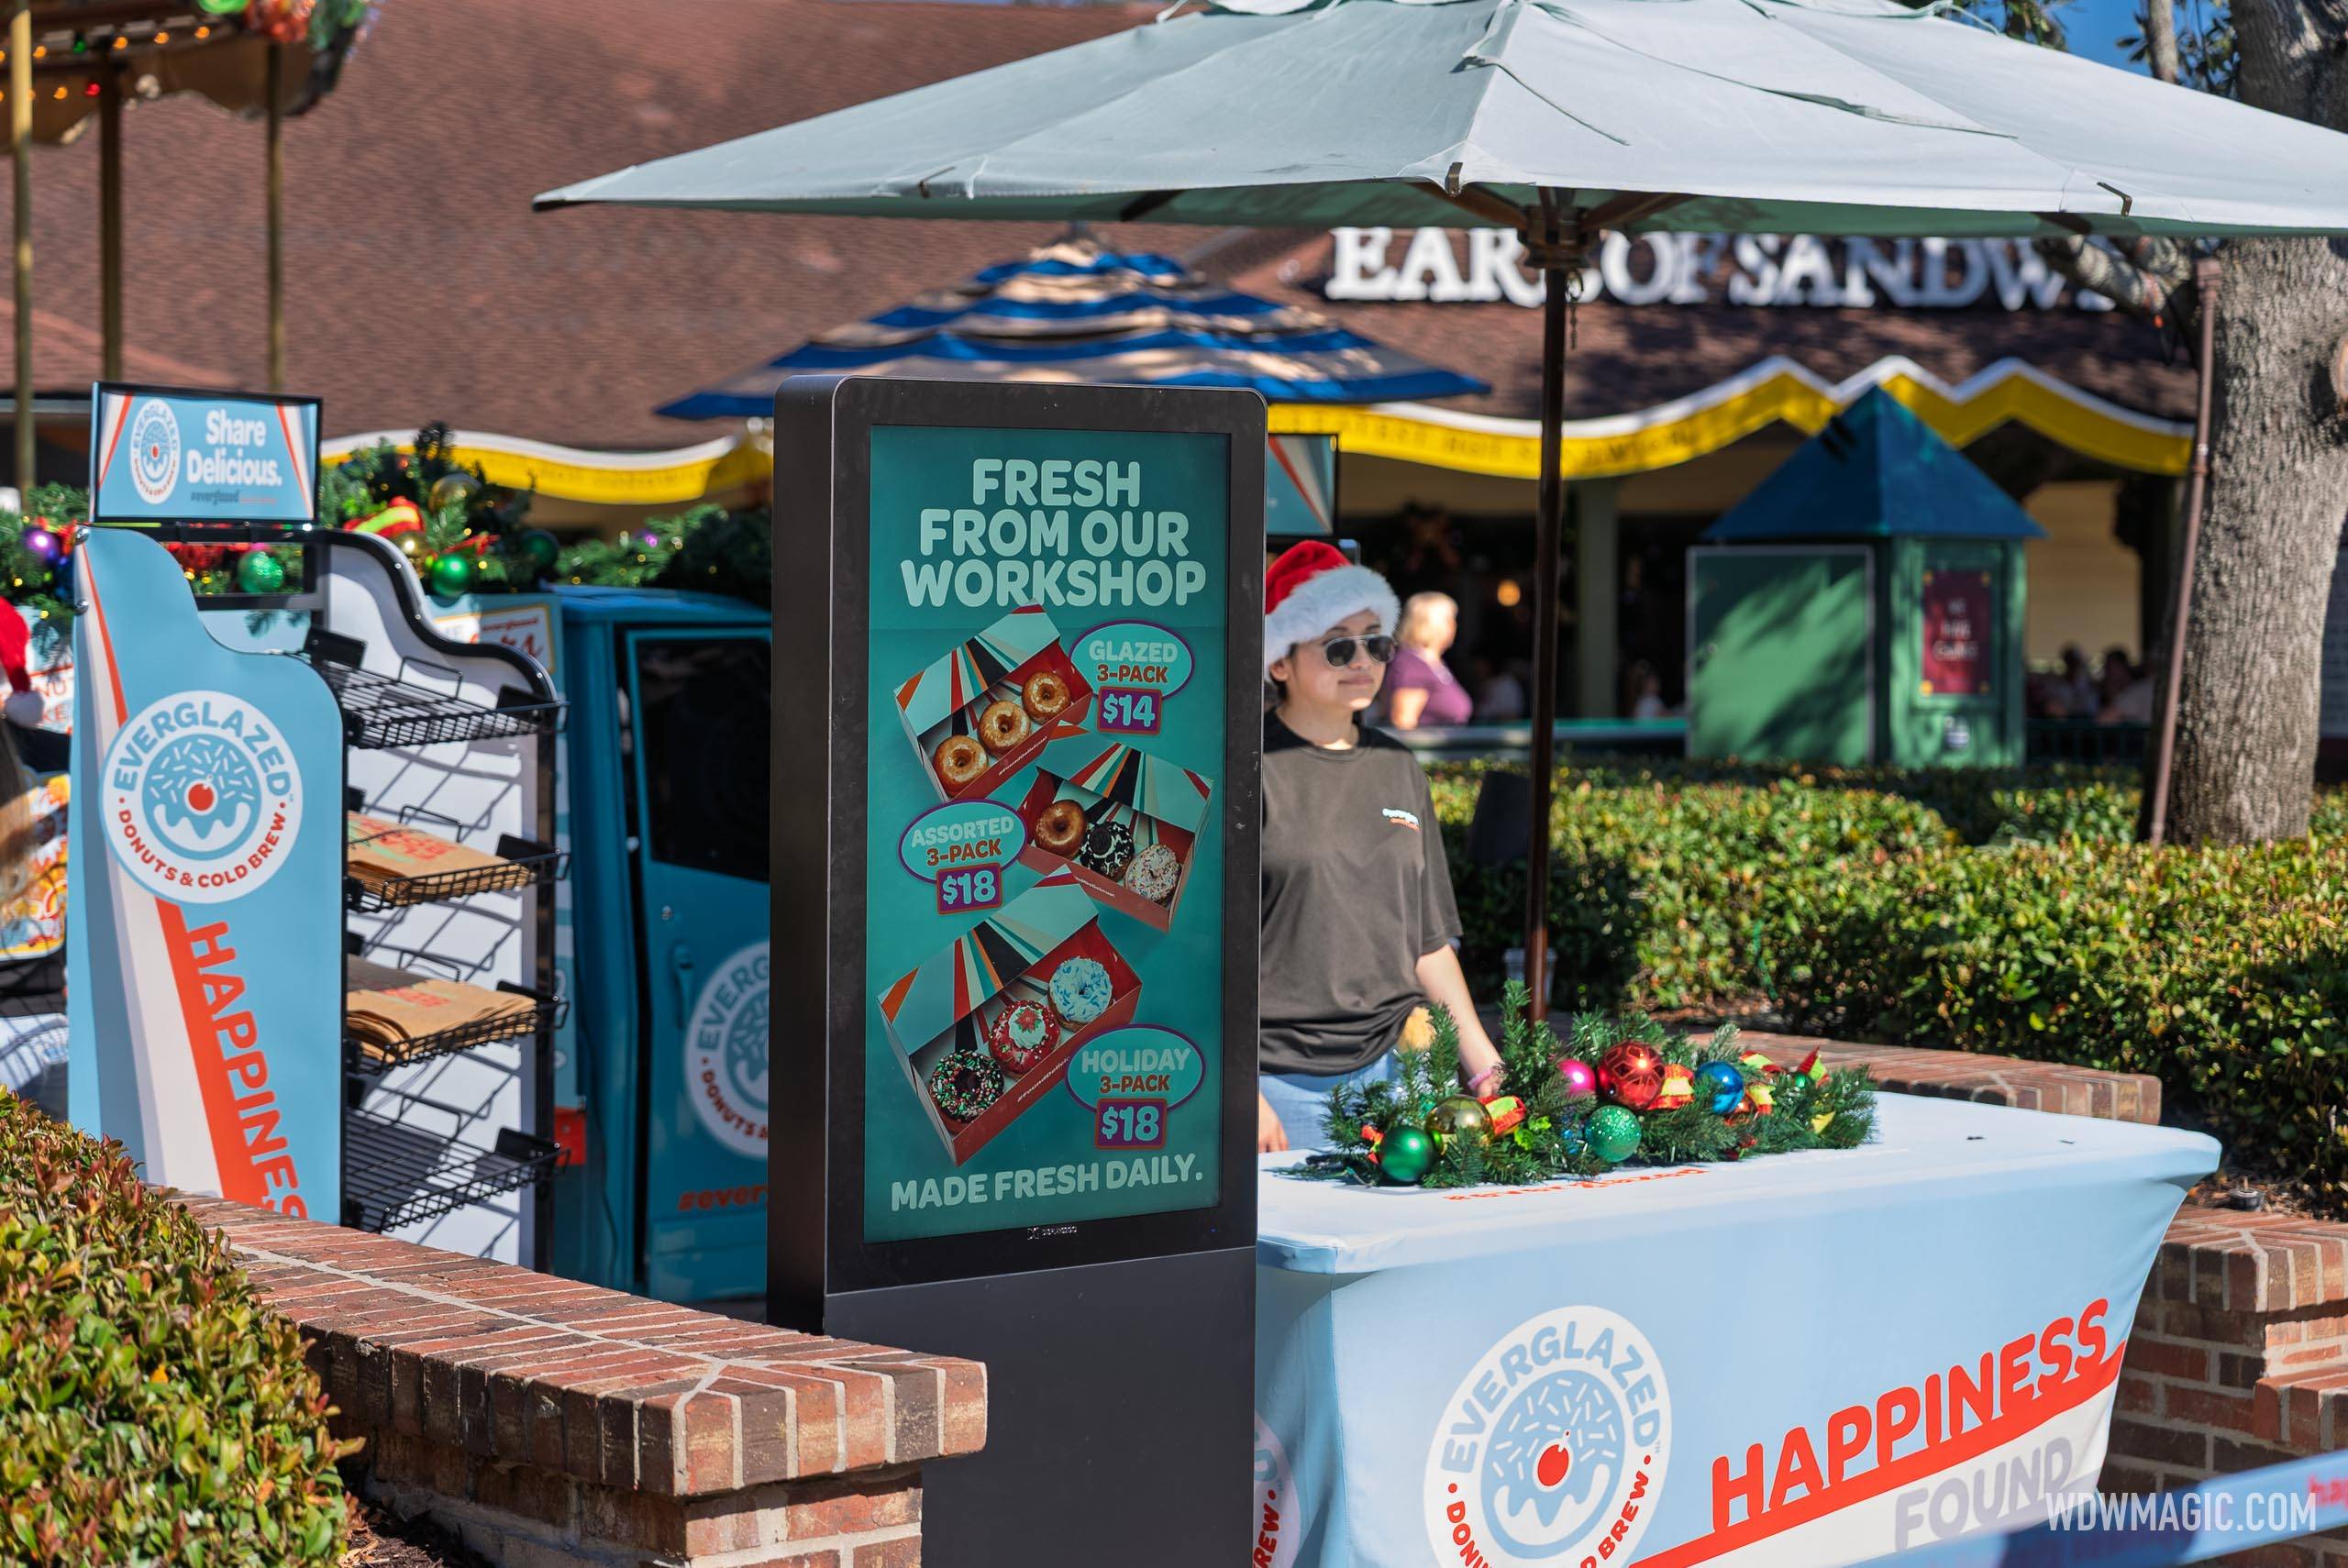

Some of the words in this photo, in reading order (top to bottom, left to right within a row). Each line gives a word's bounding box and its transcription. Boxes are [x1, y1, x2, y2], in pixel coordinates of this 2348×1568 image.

[1600, 230, 1722, 305] OF
[1728, 233, 2117, 310] SANDW
[205, 409, 267, 447] Share
[186, 447, 282, 487] Delicious.
[973, 458, 1141, 507] FRESH
[919, 509, 1069, 557] FROM
[1080, 511, 1190, 558] OUR
[901, 559, 1207, 607] WORKSHOP
[1089, 640, 1179, 663] GLAZED
[1097, 664, 1169, 684] 3-PACK
[1102, 693, 1156, 727] $14
[114, 701, 292, 797] EVERGLAZED
[118, 810, 178, 881] DONUTS
[180, 872, 194, 887] &
[197, 865, 249, 888] COLD
[248, 812, 287, 869] BREW
[911, 816, 1014, 848] ASSORTED
[926, 837, 1002, 867] 3-PACK
[942, 869, 996, 905] $18
[697, 954, 769, 1051] EVERG
[187, 921, 309, 1219] HAPPINES
[1081, 1048, 1191, 1074] HOLIDAY
[1100, 1074, 1171, 1094] 3-PACK
[702, 1069, 755, 1138] DONUTS
[1102, 1106, 1159, 1142] $18
[678, 1183, 769, 1211] #ever
[891, 1174, 988, 1212] MADE
[994, 1164, 1099, 1199] FRESH
[1105, 1154, 1203, 1189] DAILY.
[1439, 1320, 1662, 1474] EVERGLAZED
[1711, 1297, 2110, 1533] HAPPINESS
[1598, 1470, 1649, 1561] BREW
[1894, 1436, 2074, 1552] FOUND
[1253, 1502, 1279, 1568] REW
